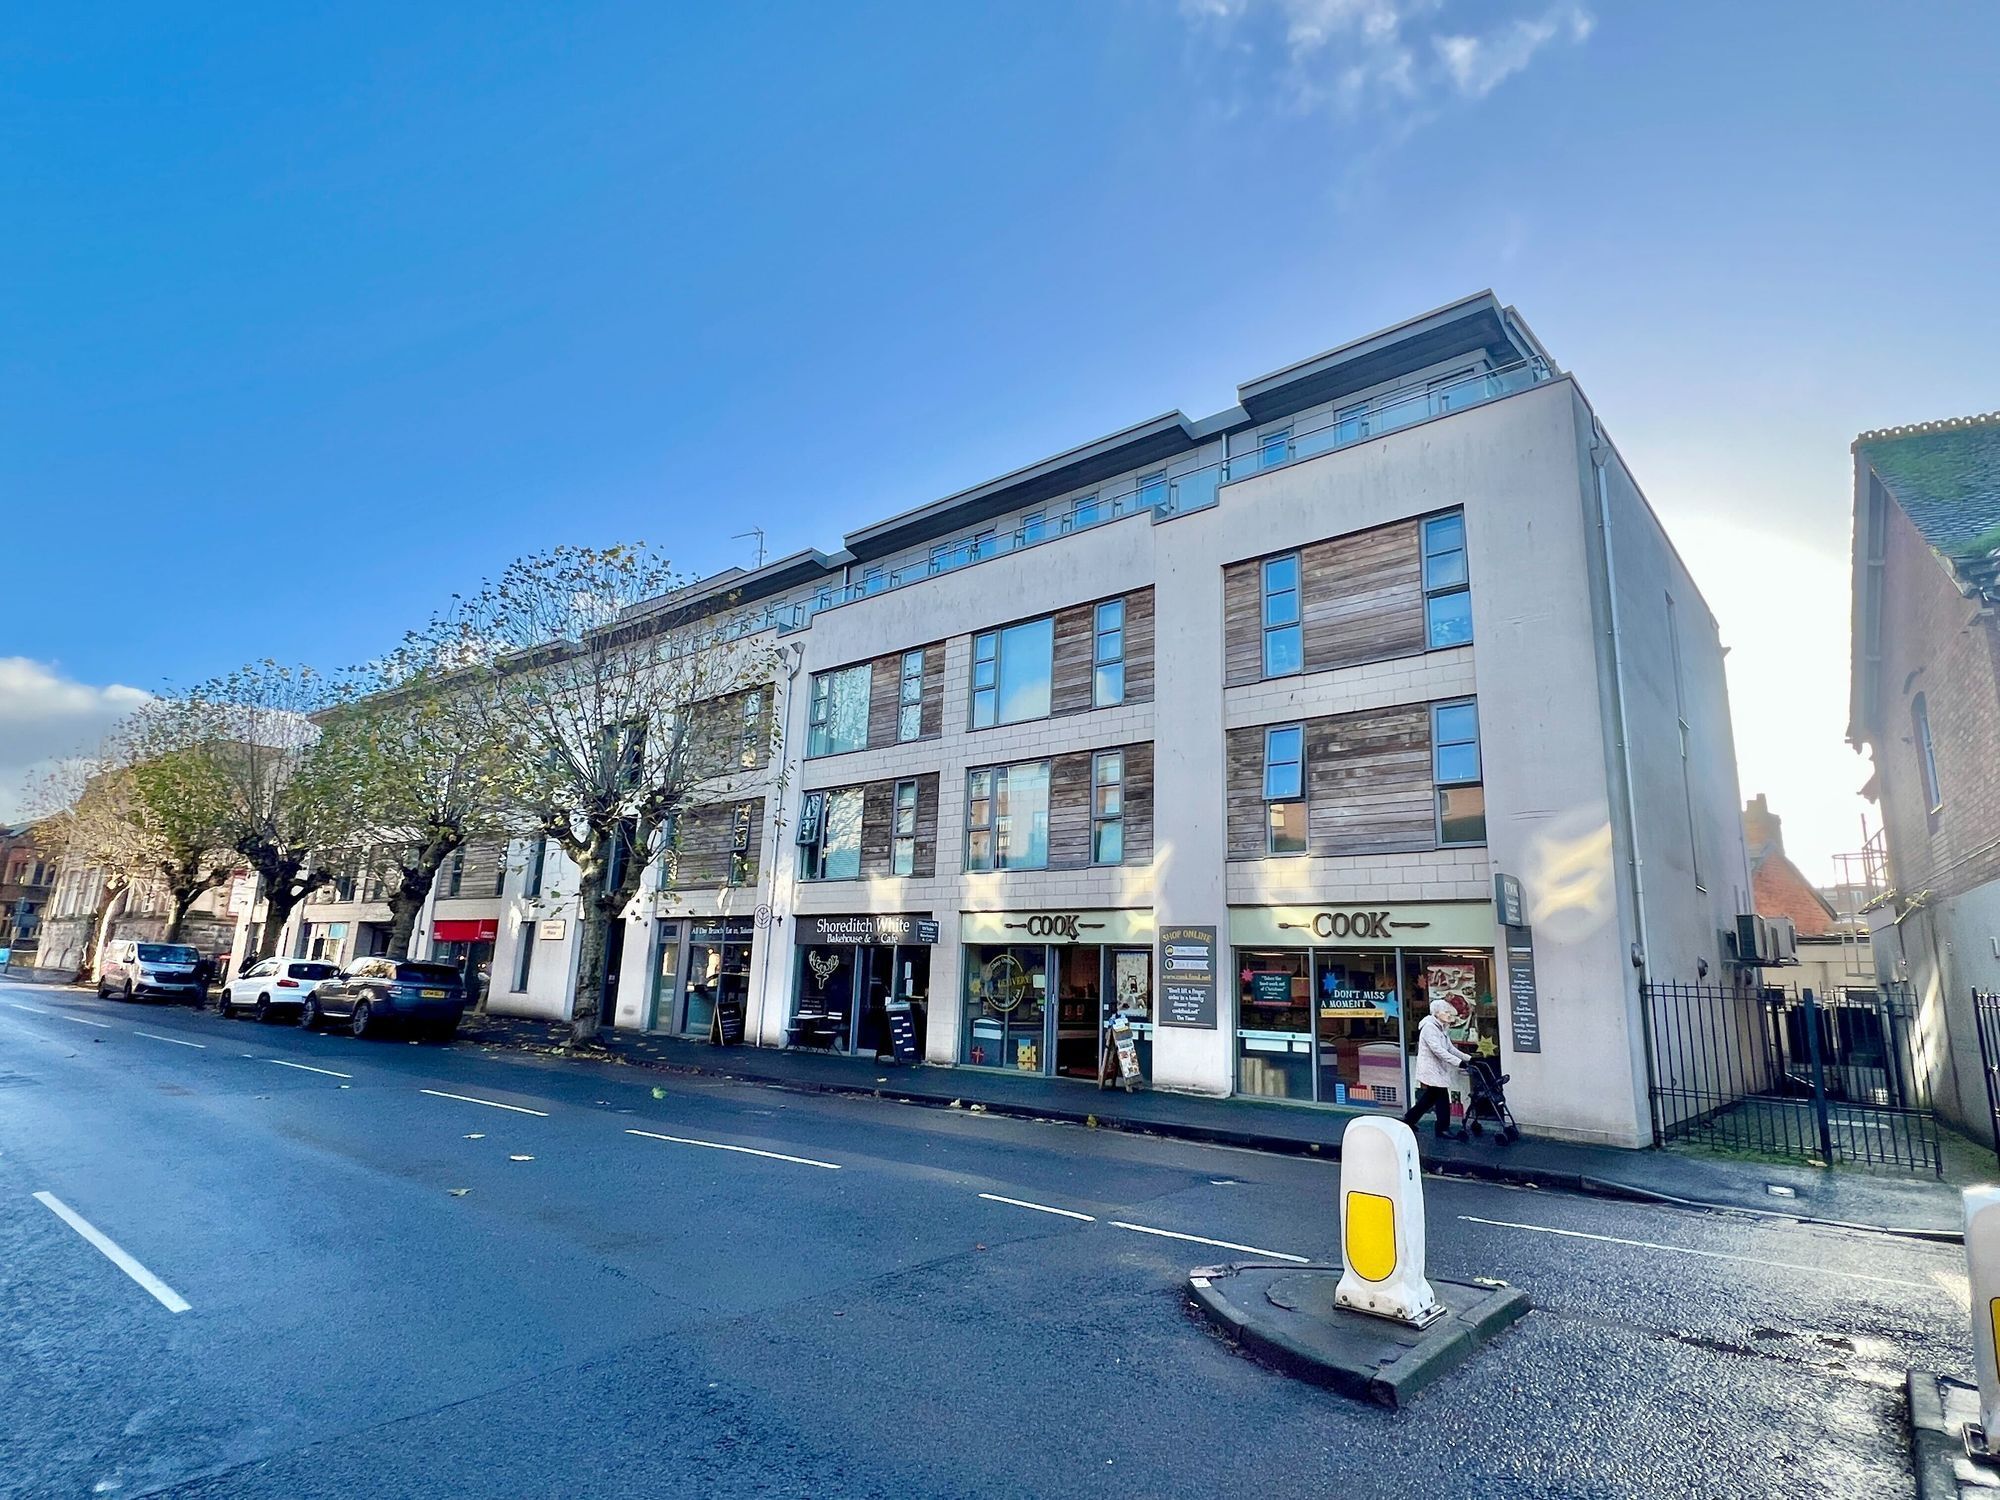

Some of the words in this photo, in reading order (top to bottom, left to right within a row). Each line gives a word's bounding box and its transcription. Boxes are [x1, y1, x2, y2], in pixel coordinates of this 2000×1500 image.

[816, 918, 873, 933] Shoreditch
[876, 916, 910, 933] White
[1027, 915, 1080, 936] COOK
[1312, 912, 1392, 938] COOK
[826, 933, 863, 943] Bakehouse
[864, 933, 871, 943] &
[1162, 930, 1182, 942] SHOP
[1183, 930, 1212, 943] ONLINE
[1334, 990, 1360, 999] DON'T
[1363, 990, 1385, 1000] MISS
[1320, 1000, 1327, 1008] A
[1329, 1000, 1366, 1008] MOMENT
